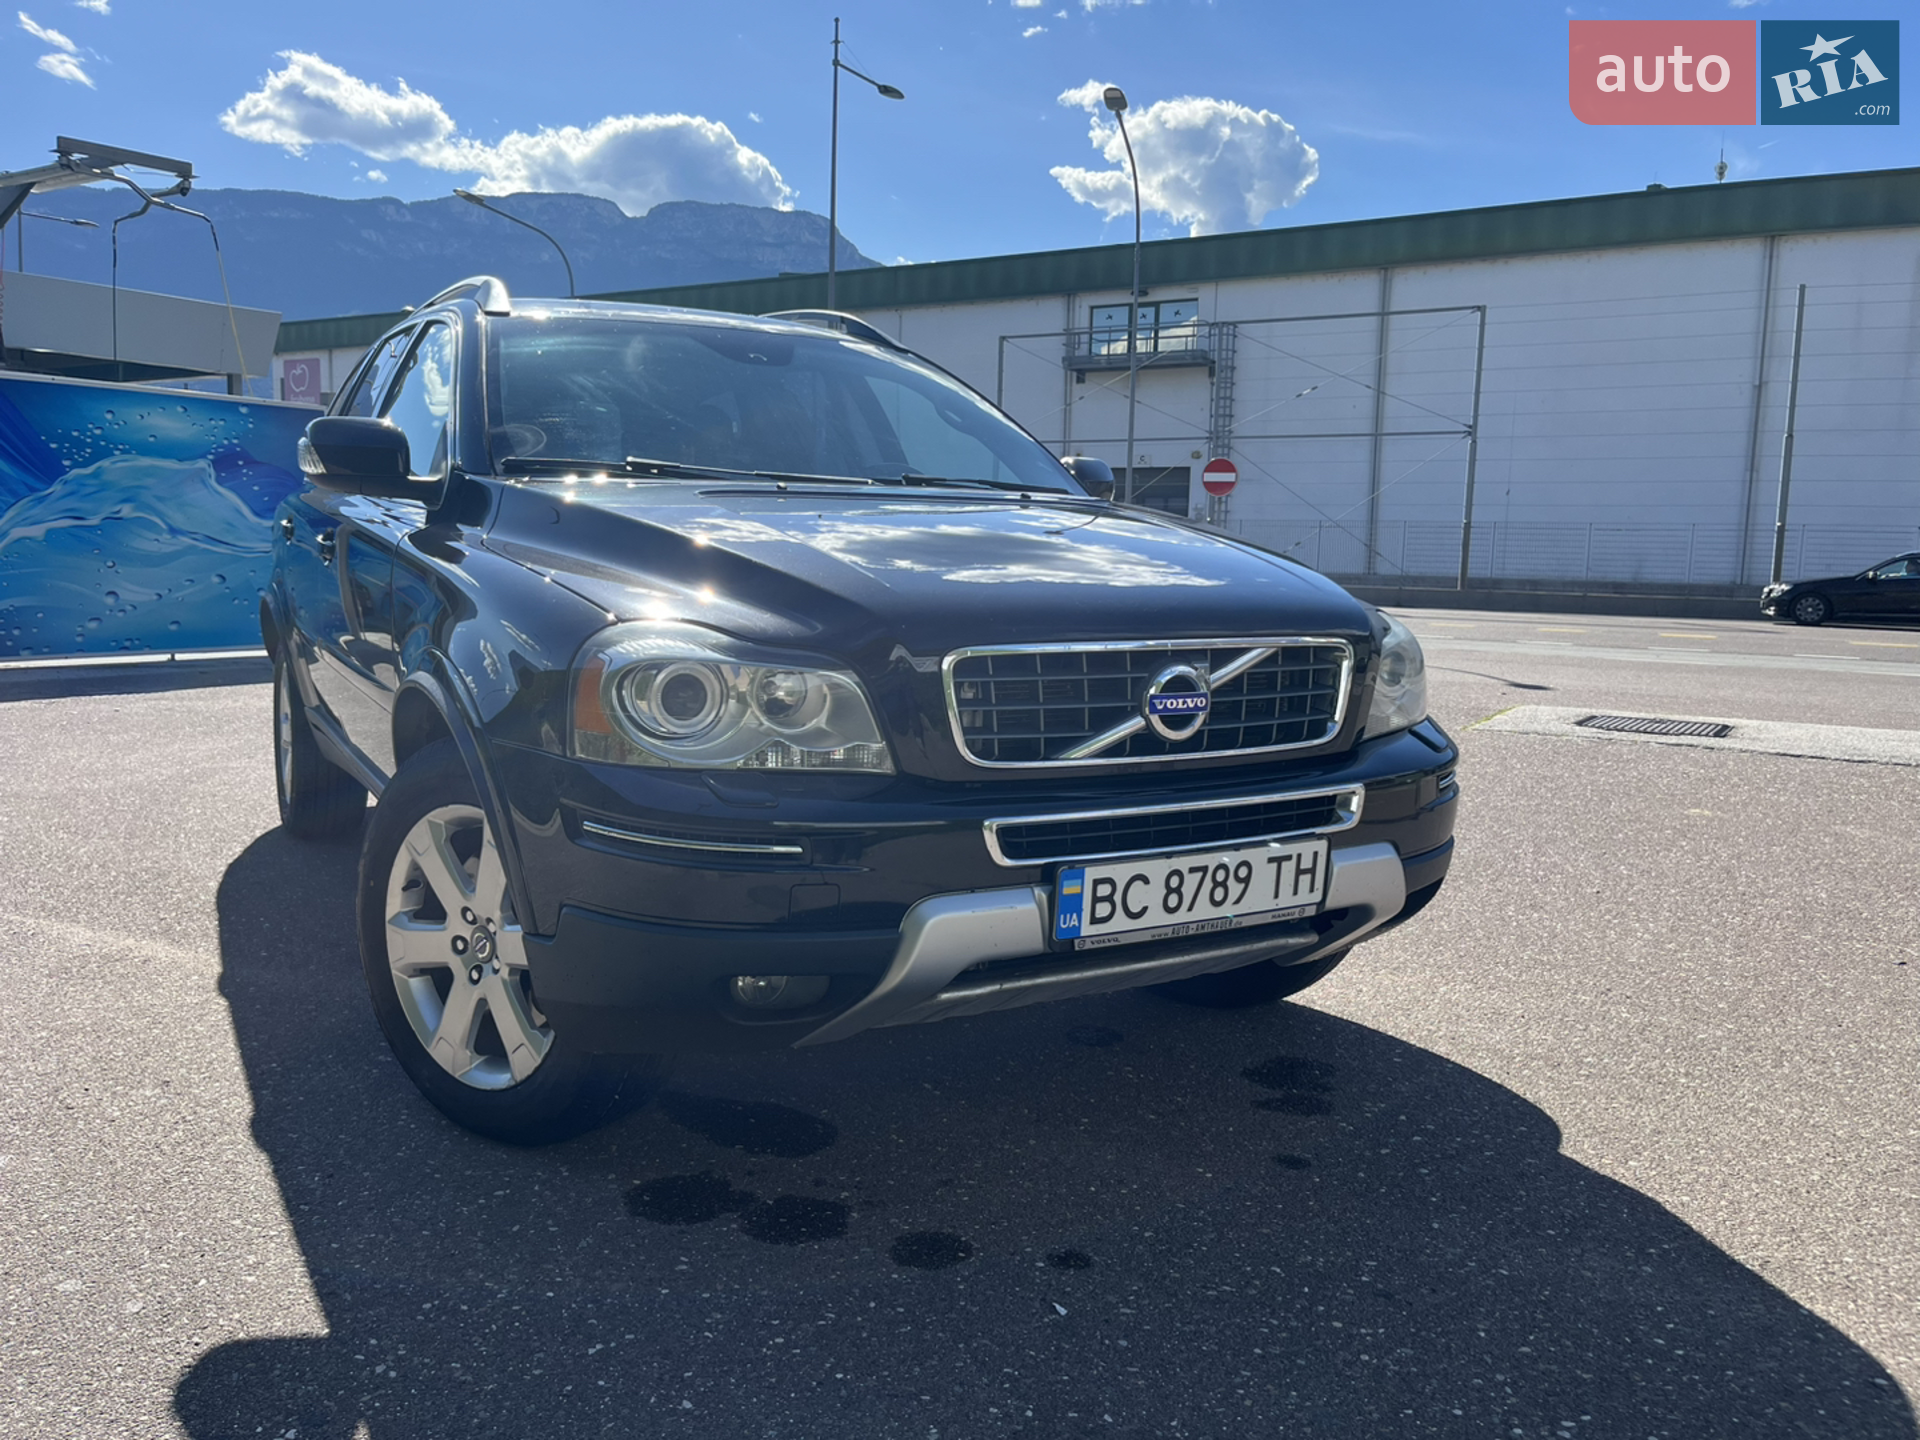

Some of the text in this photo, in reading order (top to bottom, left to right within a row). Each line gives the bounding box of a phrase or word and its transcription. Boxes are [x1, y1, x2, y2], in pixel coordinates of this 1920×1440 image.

[1152, 697, 1207, 710] VOLVO
[1089, 850, 1319, 926] BC 8789 TH
[1059, 914, 1079, 929] UA
